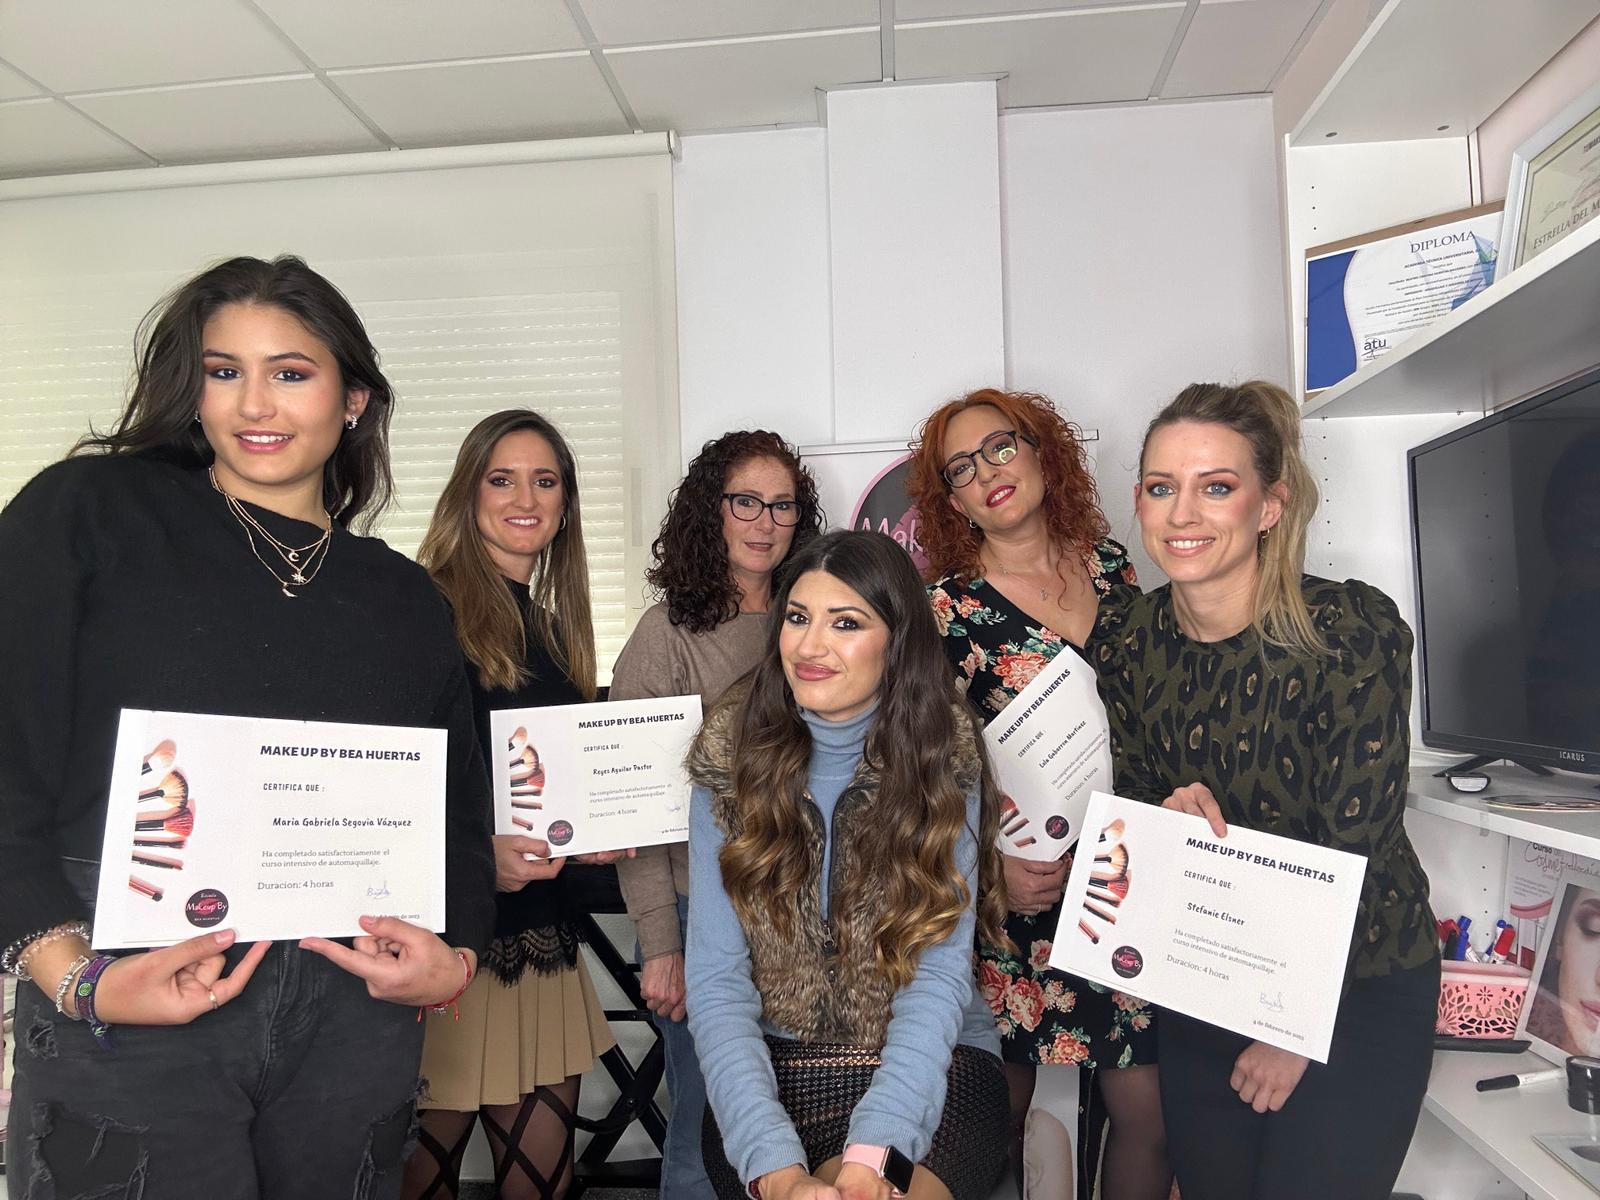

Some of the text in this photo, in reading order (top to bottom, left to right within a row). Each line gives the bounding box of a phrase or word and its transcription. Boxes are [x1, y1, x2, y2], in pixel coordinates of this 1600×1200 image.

[1533, 222, 1570, 249] ESTRELLA
[1573, 208, 1588, 224] DEL
[1411, 231, 1476, 253] DIPLOMA
[1364, 339, 1386, 350] atu
[998, 669, 1070, 744] MAKE UP BY BEA HUERTAS
[579, 721, 603, 729] MAKE
[647, 713, 685, 723] HUERTAS
[260, 746, 421, 761] MAKE UP BY BEA HUERTAS
[1559, 751, 1585, 761] ICARUS
[263, 783, 302, 791] CERTIFICA
[303, 818, 340, 827] Gabriela
[342, 818, 374, 828] Segovia
[377, 818, 411, 828] Vázquez
[274, 850, 317, 859] completado
[318, 849, 380, 857] satisfactoriamente
[1186, 838, 1335, 883] MAKE UP BY BEA HUERTAS
[257, 882, 301, 890] Duracion:
[1184, 871, 1231, 889] CERTIFICA QUE
[1187, 903, 1245, 926] Stefanie Elsner
[1173, 938, 1189, 947] curso
[1191, 943, 1218, 956] intensivo
[1185, 932, 1220, 947] completado
[1167, 954, 1201, 971] Duracion:
[1209, 968, 1229, 981] horas
